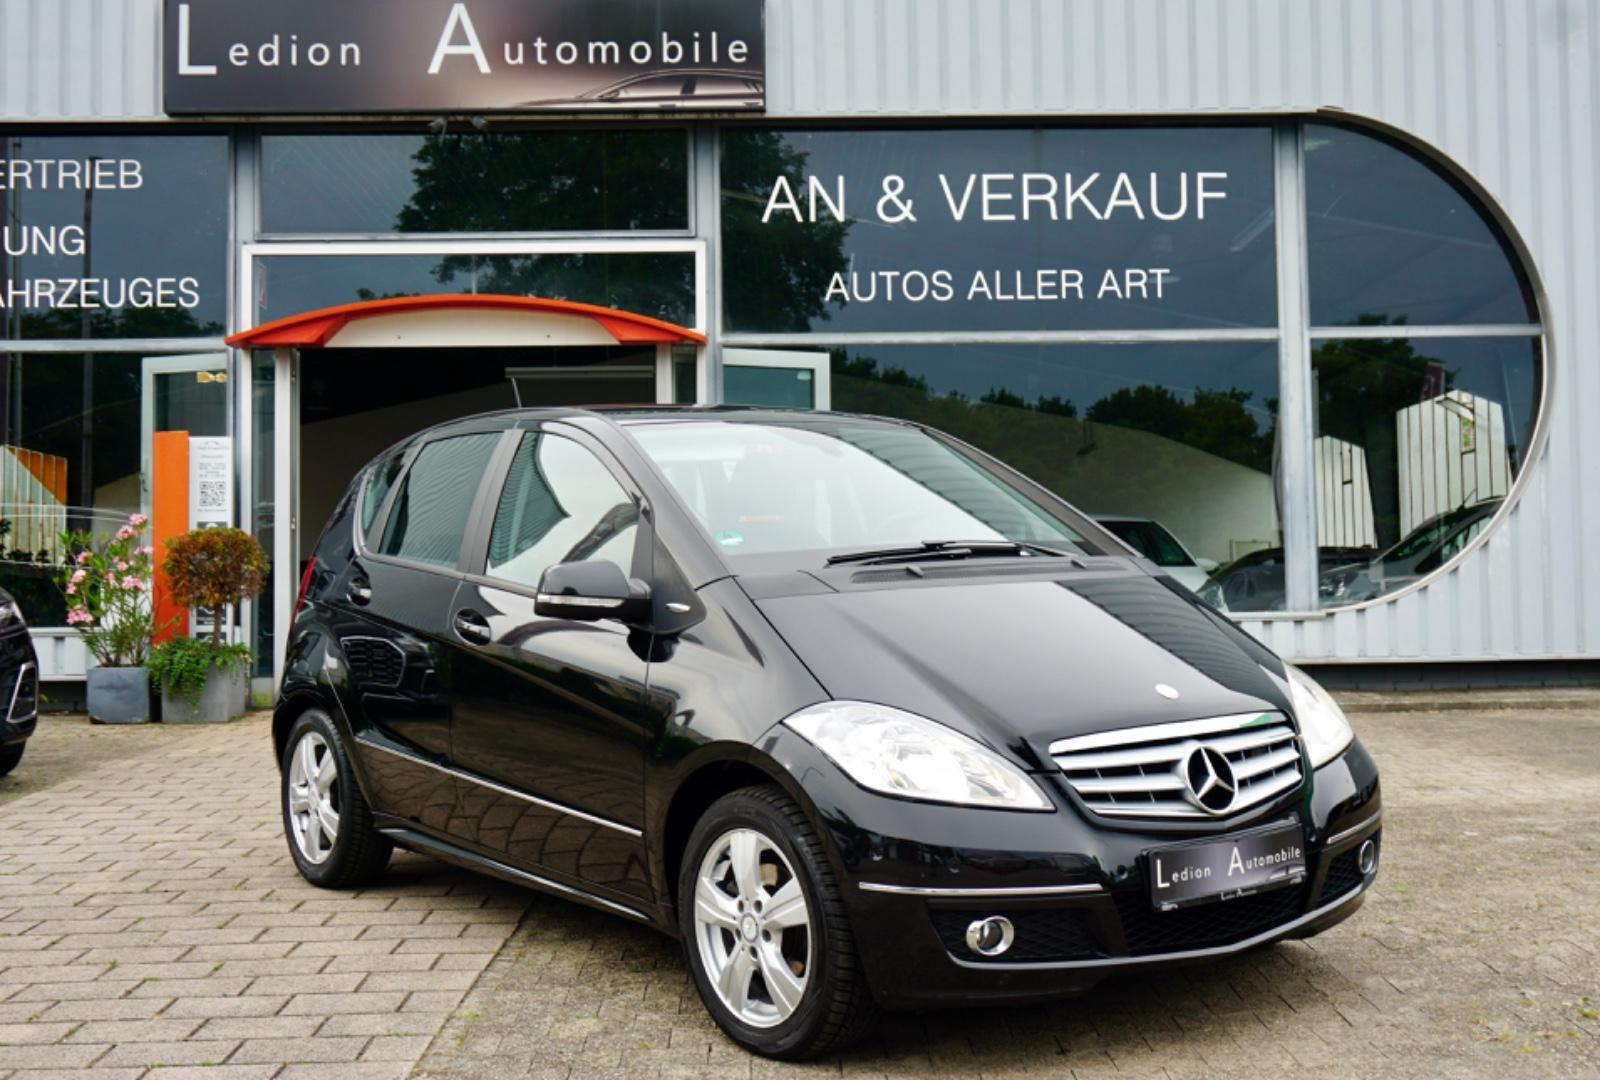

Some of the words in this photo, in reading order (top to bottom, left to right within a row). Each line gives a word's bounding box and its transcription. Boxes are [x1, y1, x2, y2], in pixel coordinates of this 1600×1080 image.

[178, 3, 360, 75] Ledion
[426, 2, 748, 75] Automobile
[0, 159, 143, 189] RTRIEB
[761, 175, 845, 223] AN
[876, 174, 917, 223] &
[938, 172, 1228, 221] VERKAUF
[0, 277, 200, 308] HRZEUGES
[824, 270, 954, 302] AUTOS
[967, 269, 1084, 300] ALLER
[1097, 268, 1170, 299] ART
[1156, 858, 1211, 888] Ledion
[1227, 846, 1301, 877] Automobile
